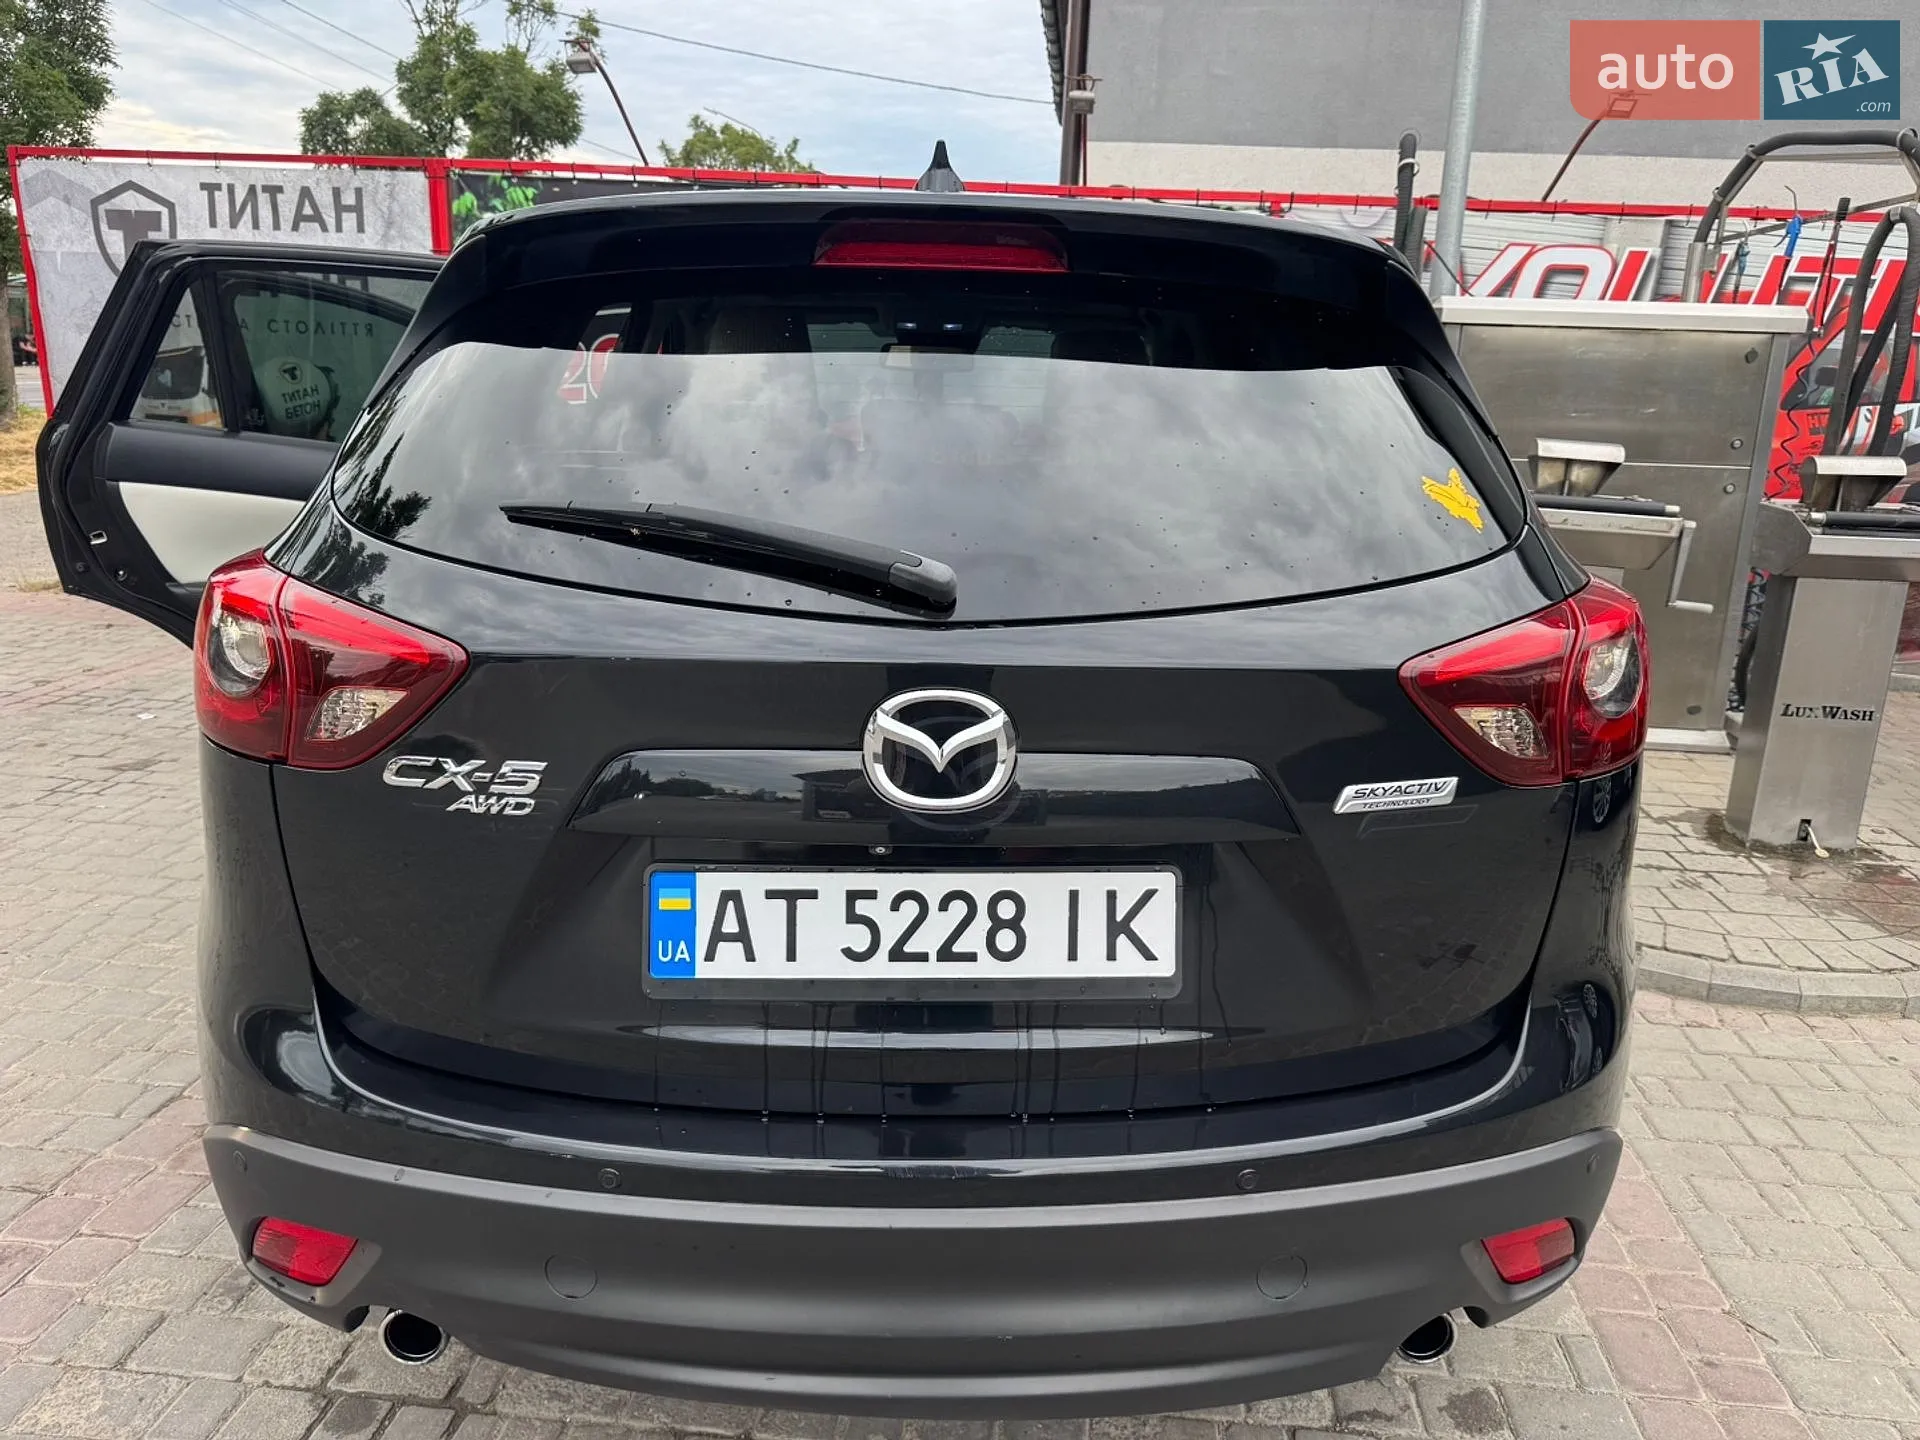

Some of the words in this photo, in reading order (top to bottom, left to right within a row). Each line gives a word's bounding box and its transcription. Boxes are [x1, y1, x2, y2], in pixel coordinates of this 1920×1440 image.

[199, 182, 365, 234] ТИТАН
[267, 318, 375, 337] СТОЛІТТЯ
[281, 385, 320, 405] ТИТАН
[284, 399, 322, 420] БЕТОН
[382, 755, 549, 796] CX-5
[1352, 780, 1448, 799] SKYACTIV
[446, 794, 536, 817] AWD
[1362, 797, 1432, 809] TECHNOLOGY
[703, 888, 819, 963] AT
[840, 888, 1027, 963] 5228
[1067, 888, 1160, 963] IK
[657, 940, 691, 964] UA
